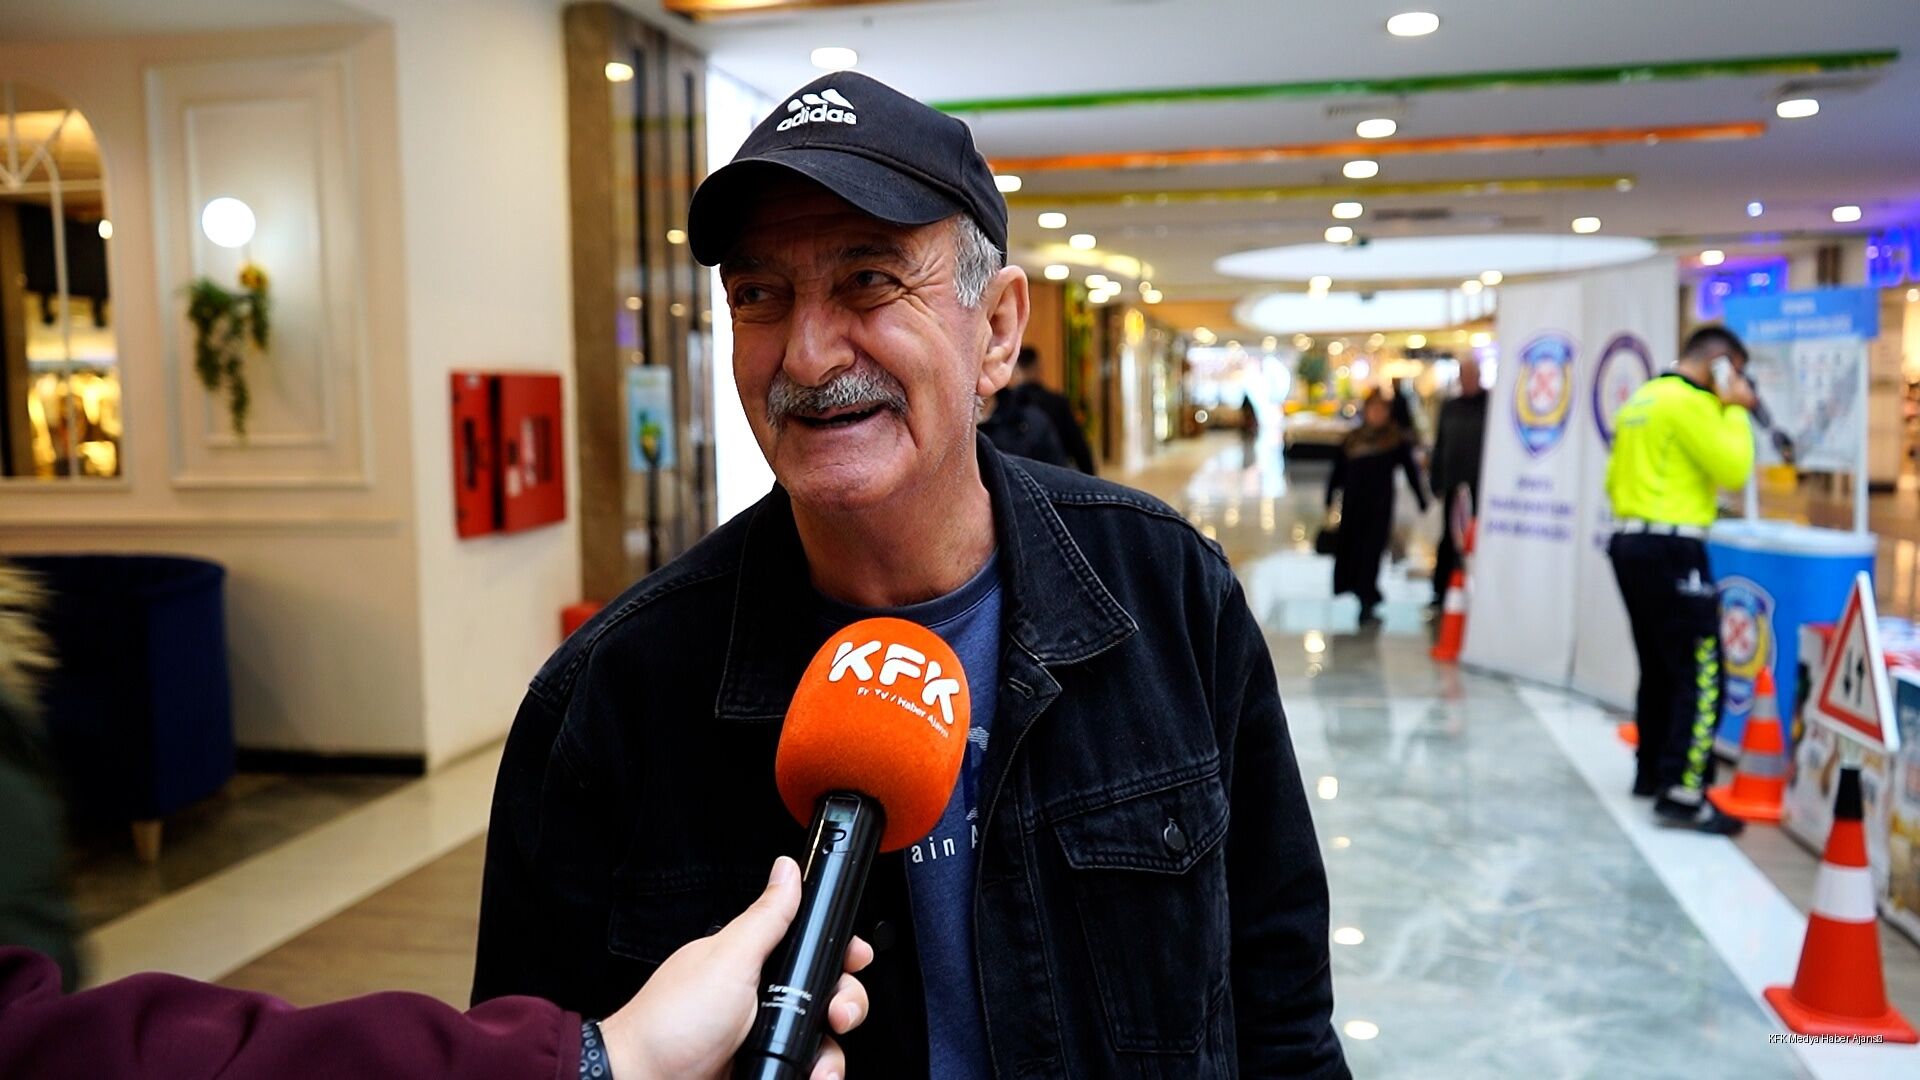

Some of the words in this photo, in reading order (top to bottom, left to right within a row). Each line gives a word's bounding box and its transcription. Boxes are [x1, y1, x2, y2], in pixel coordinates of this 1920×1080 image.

[776, 103, 857, 132] adidas
[828, 640, 960, 725] KFK
[911, 836, 956, 864] ain
